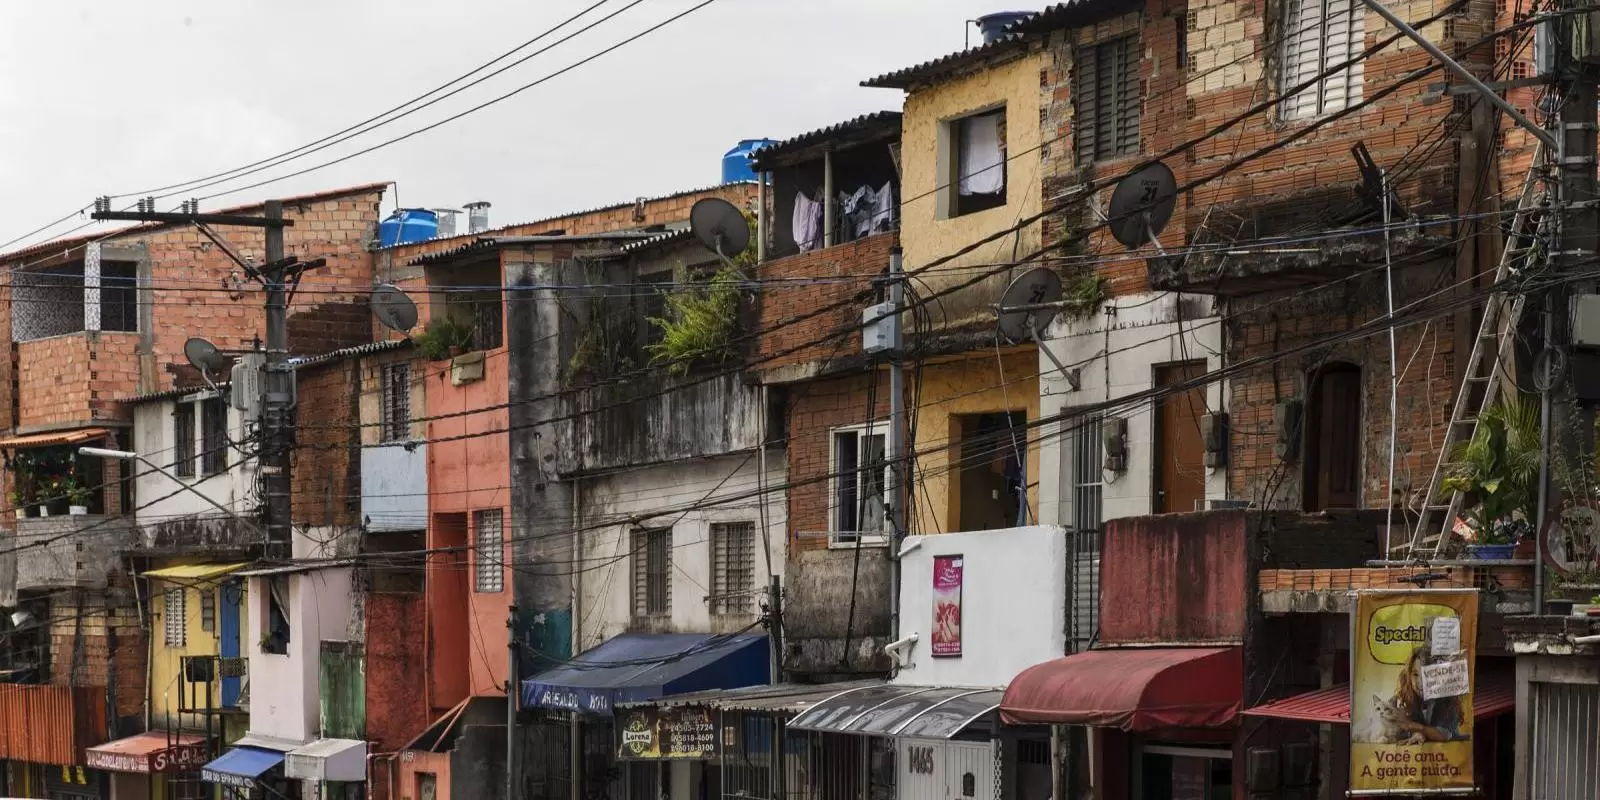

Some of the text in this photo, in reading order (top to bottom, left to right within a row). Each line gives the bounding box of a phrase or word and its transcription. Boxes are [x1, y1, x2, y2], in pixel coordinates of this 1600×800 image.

[1375, 626, 1425, 644] Special
[908, 746, 933, 775] 1465
[1374, 749, 1448, 763] Você ama.
[1360, 763, 1461, 779] A gente cuida.
